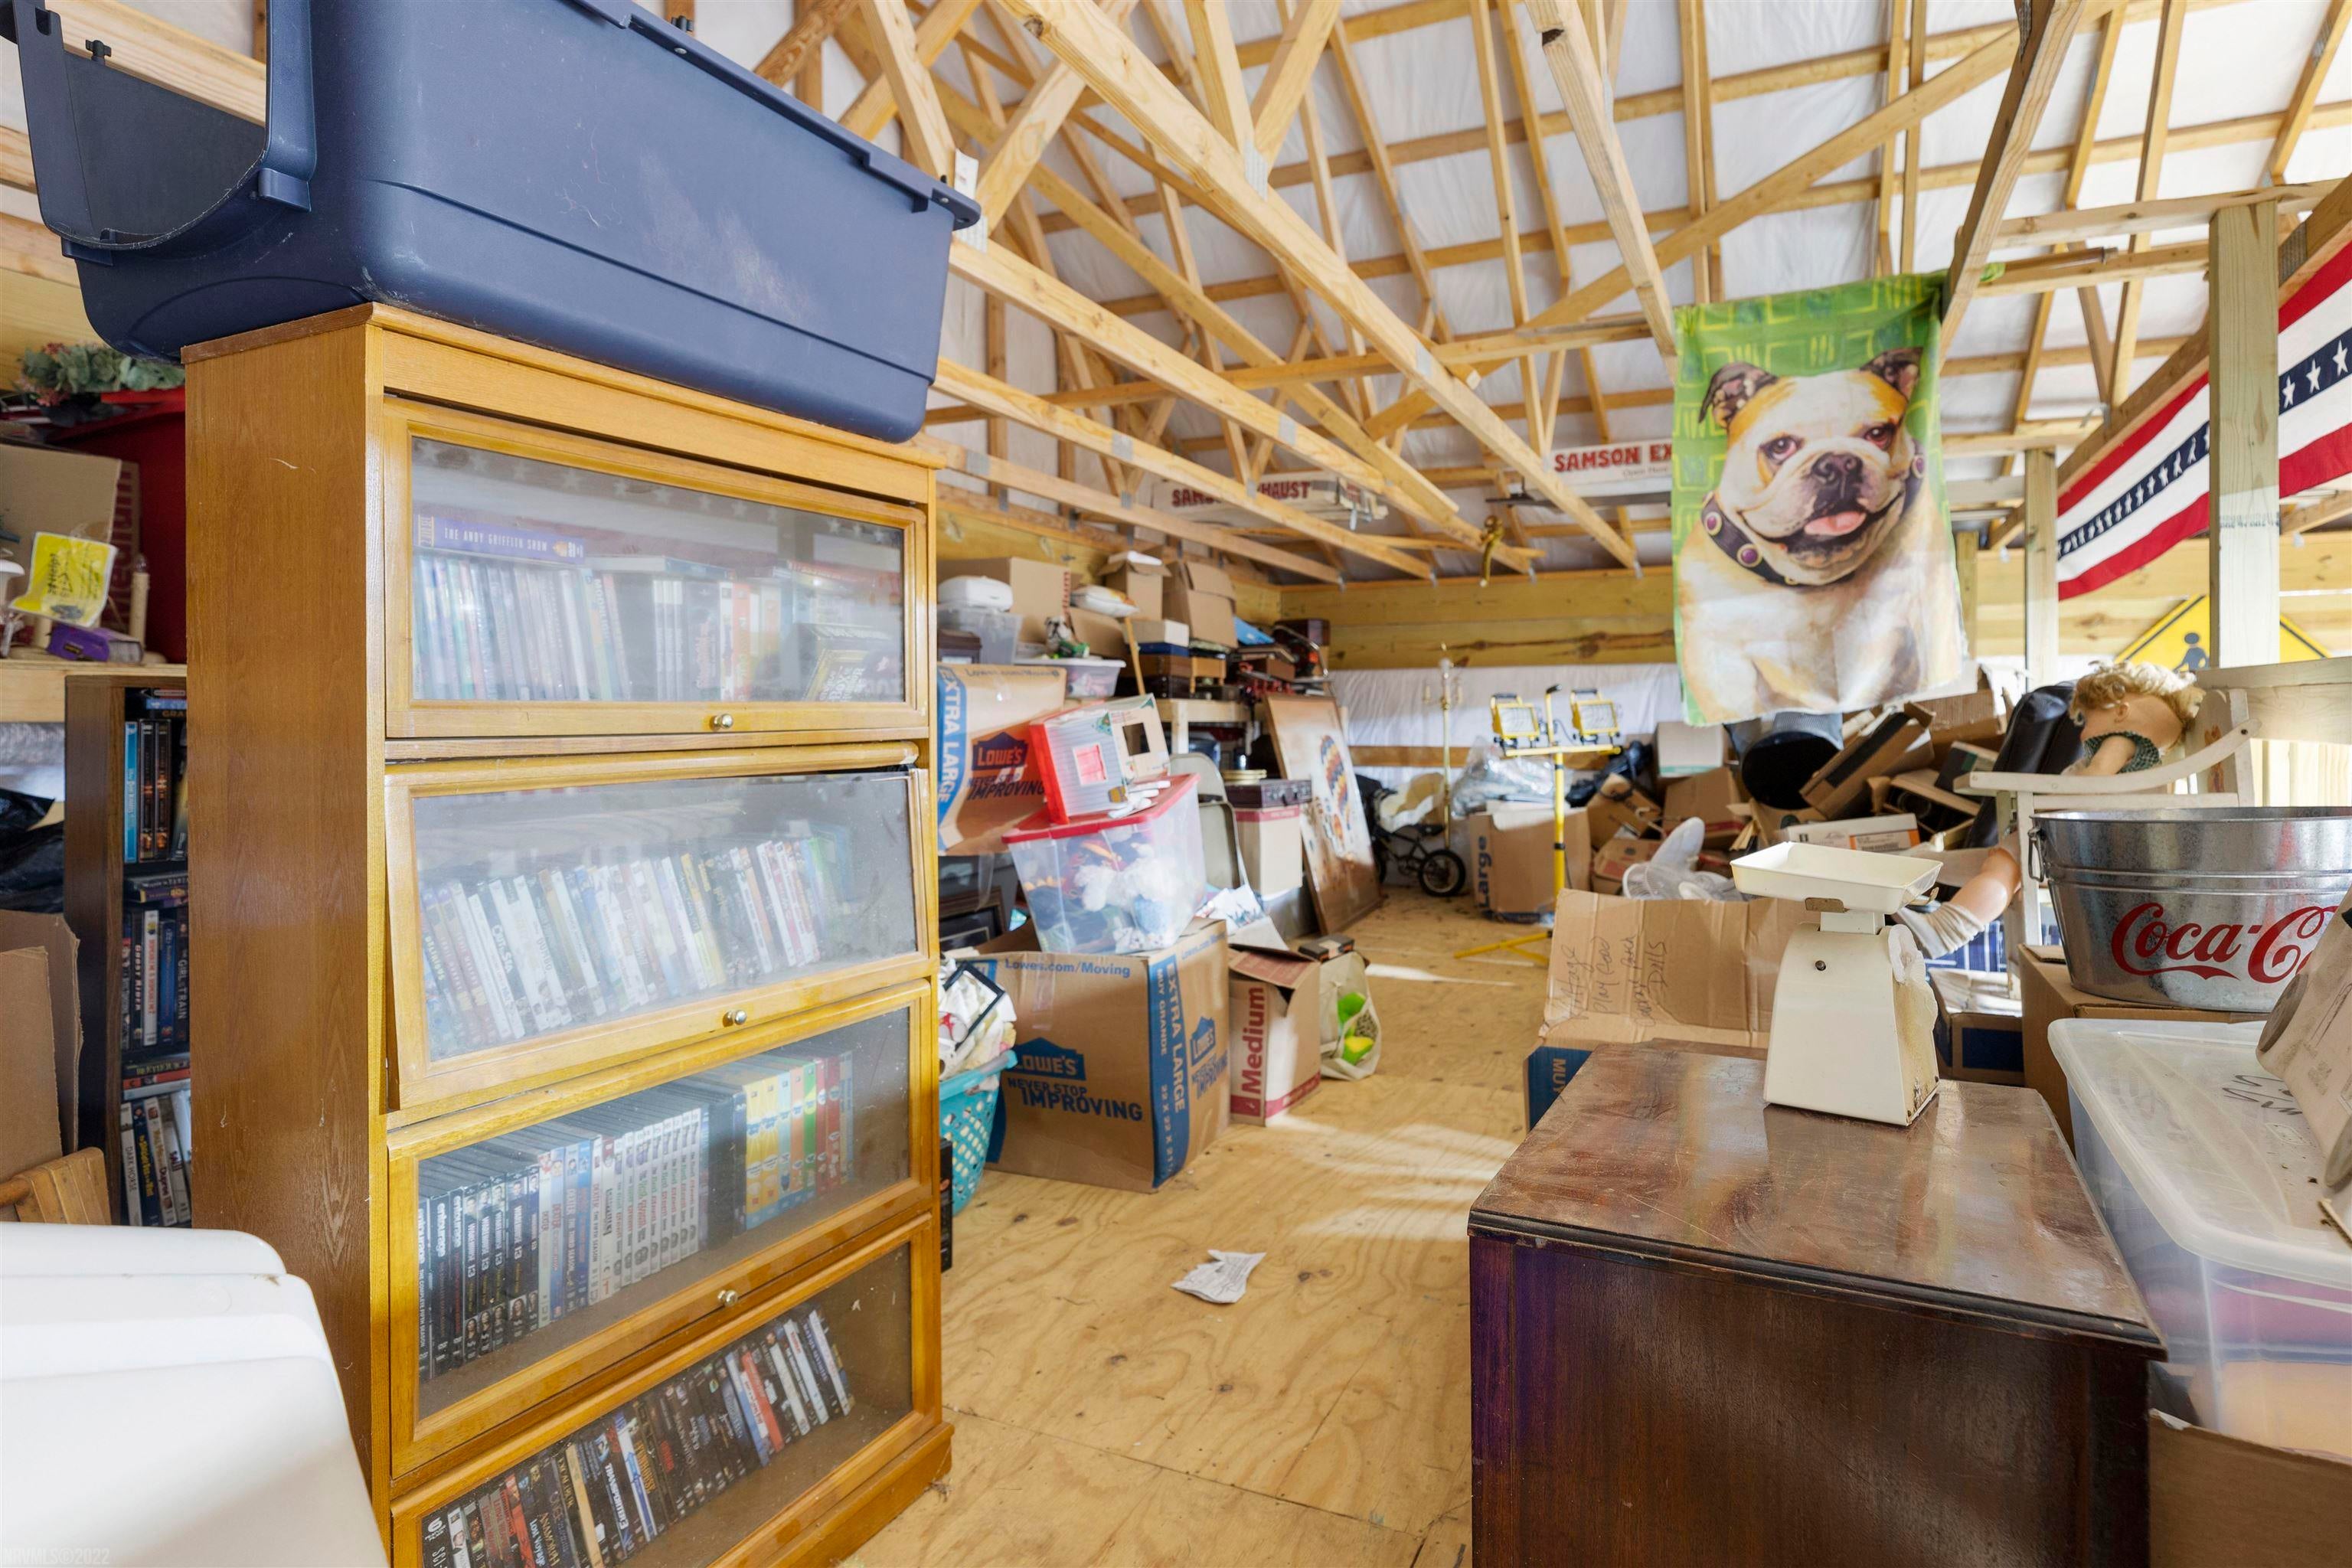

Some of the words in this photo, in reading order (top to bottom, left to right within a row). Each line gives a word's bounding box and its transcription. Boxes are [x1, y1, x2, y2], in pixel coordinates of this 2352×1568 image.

[1555, 446, 1642, 472] SAMSON
[939, 666, 960, 735] EXTRA
[939, 742, 959, 802] LARGE
[977, 746, 1023, 766] LOWE'S
[967, 780, 1046, 801] IMPROVING
[1478, 835, 1492, 907] Large
[2111, 902, 2340, 984] Coca-C
[1005, 959, 1131, 978] Lowes.com/Moving
[178, 988, 188, 1020] TRAIN
[1167, 963, 1182, 1039] EXTRA
[1159, 1000, 1168, 1056] GRANDE
[1241, 986, 1266, 1095] Medium
[1008, 1077, 1050, 1093] NEVER
[1053, 1083, 1087, 1096] STOP
[1172, 1043, 1185, 1113] LARGE
[1020, 1086, 1143, 1122] IMPROVING
[567, 1188, 576, 1214] DEXTER
[436, 1203, 446, 1257] entourage
[452, 1196, 462, 1248] entourage
[482, 1217, 490, 1256] WAREHOUSE
[495, 1212, 503, 1250] WAREHOUSE
[514, 1206, 522, 1243] WAREHOUSE
[467, 1223, 475, 1262] WAREHOUSE
[495, 1252, 503, 1266] 13
[514, 1245, 522, 1259] 13
[468, 1264, 475, 1278] 13
[482, 1257, 489, 1271] 13
[605, 1462, 628, 1521] TRANSPORTER
[619, 1521, 629, 1530] 3
[432, 1547, 448, 1568] SCI-
